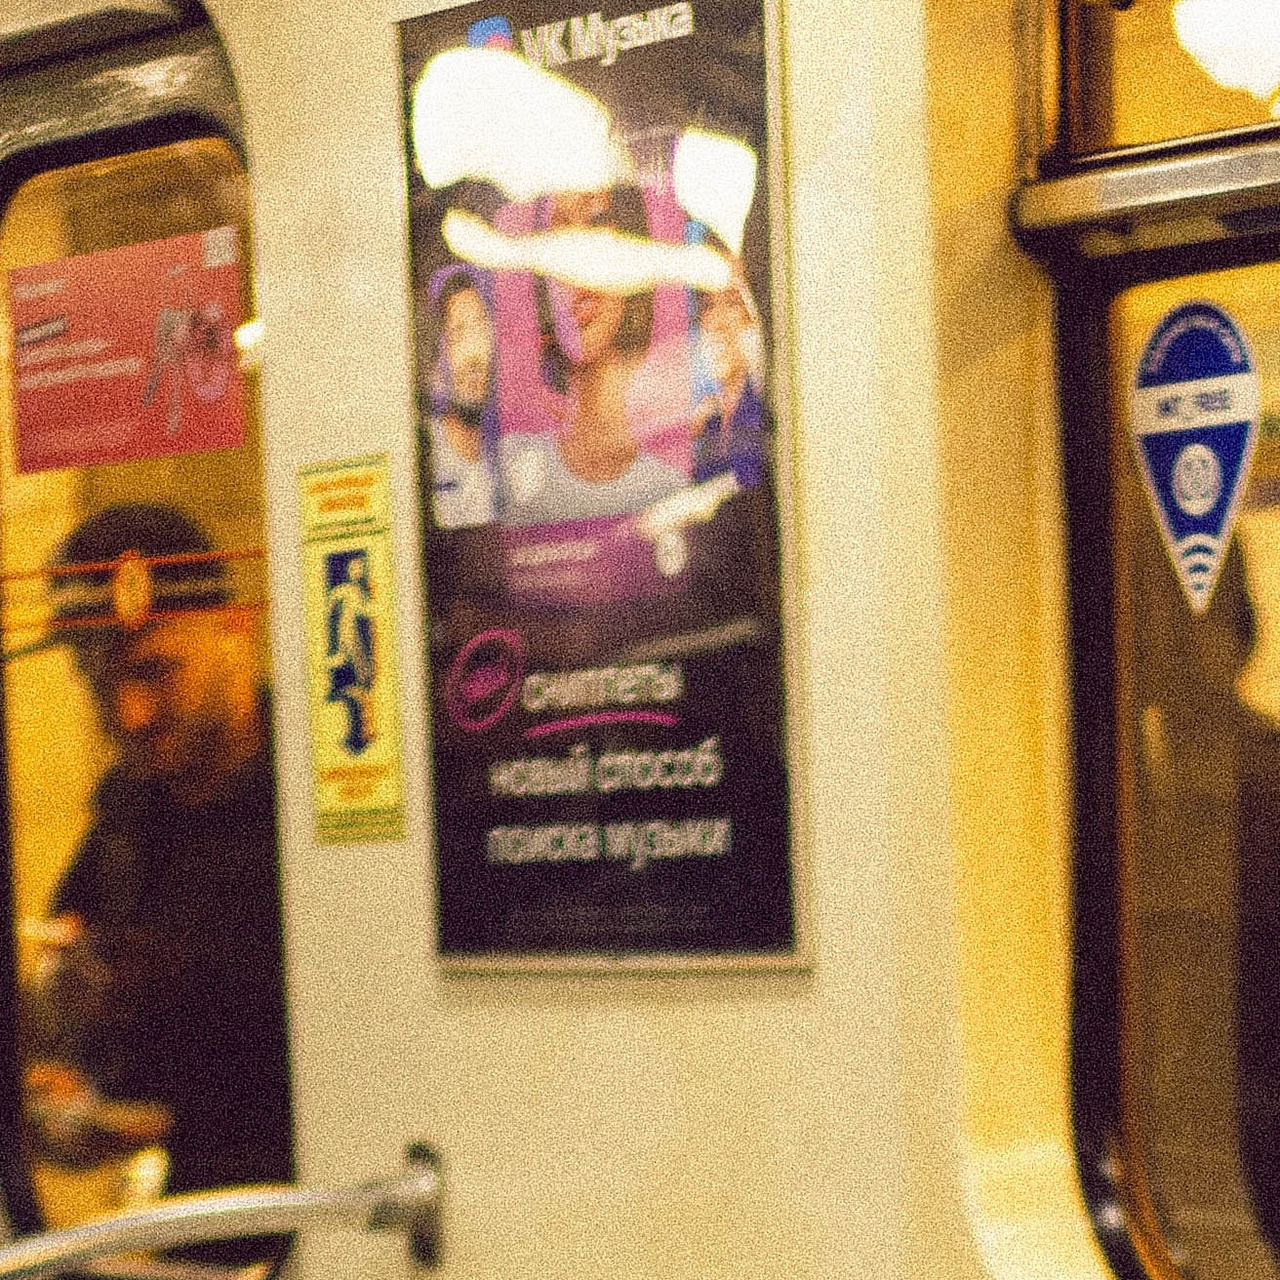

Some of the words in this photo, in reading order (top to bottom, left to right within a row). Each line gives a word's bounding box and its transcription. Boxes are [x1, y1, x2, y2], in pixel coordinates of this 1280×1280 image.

[570, 2, 693, 66] Музыка
[489, 743, 591, 797] новый
[597, 736, 722, 792] способ
[603, 815, 731, 872] музыки
